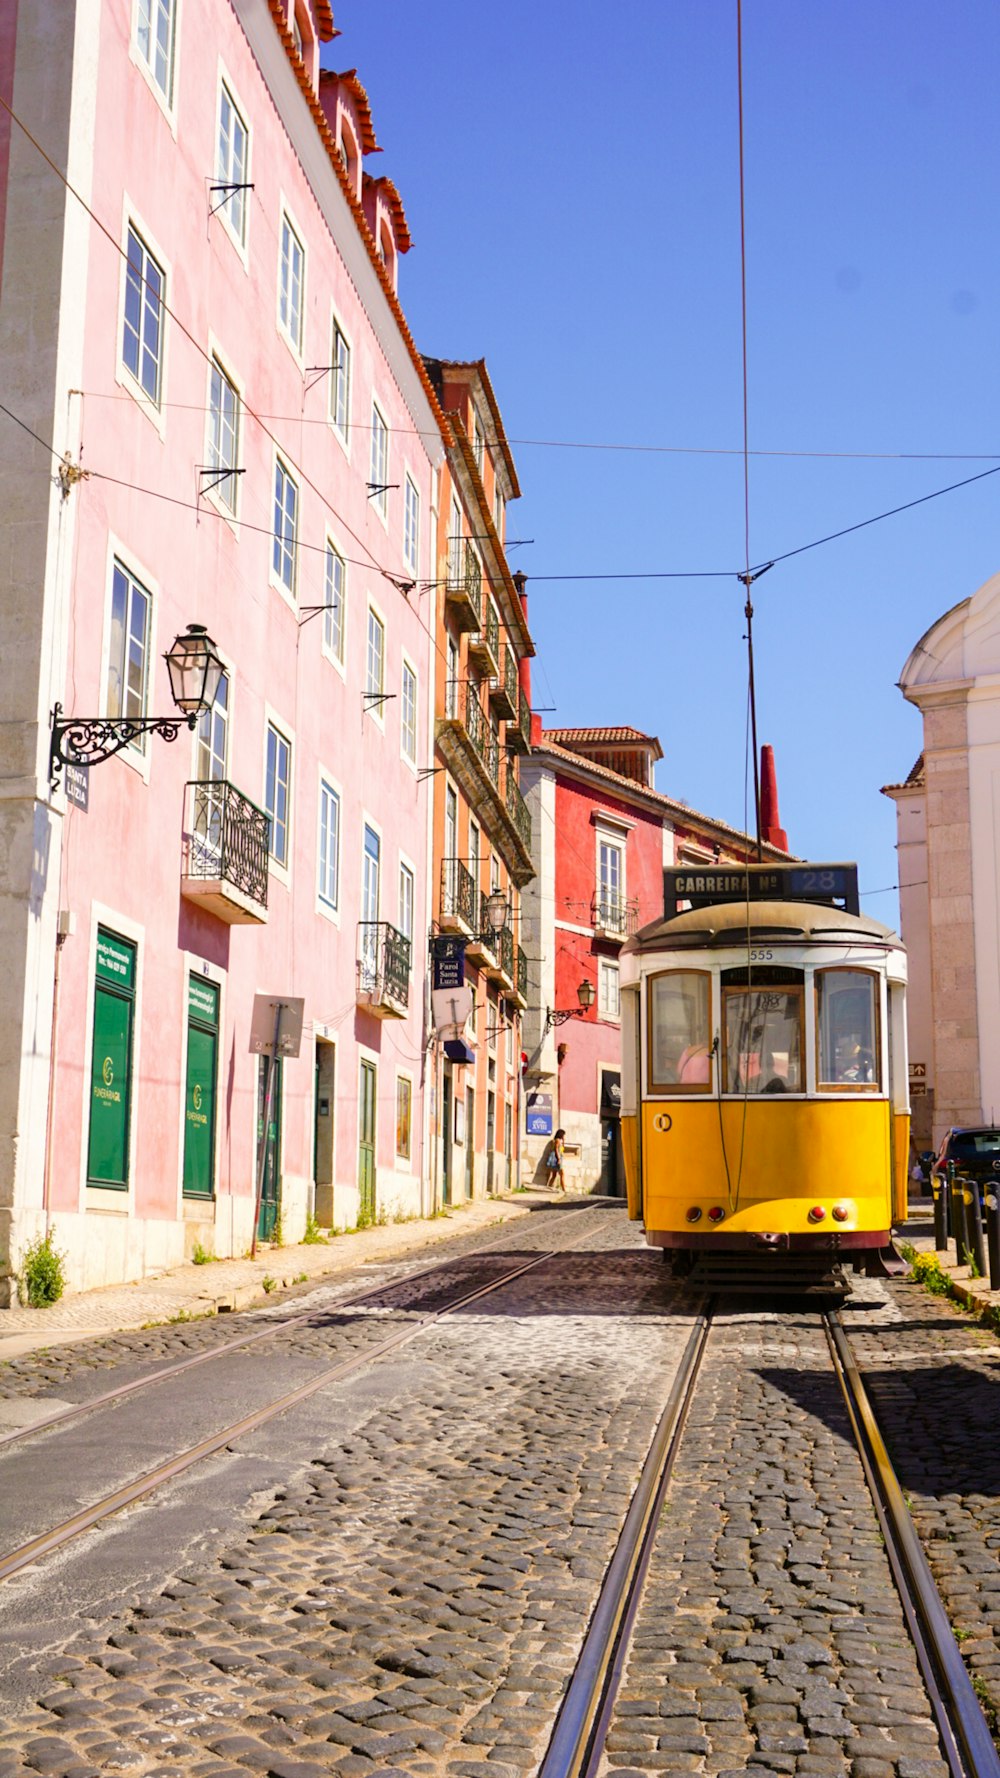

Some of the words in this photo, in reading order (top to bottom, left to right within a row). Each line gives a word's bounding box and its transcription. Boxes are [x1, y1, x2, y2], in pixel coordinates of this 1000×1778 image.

[66, 765, 88, 789] SANTA
[66, 781, 87, 804] LUZIA
[675, 876, 749, 893] CARREIRA
[802, 870, 836, 891] 28
[750, 950, 774, 961] 555
[439, 962, 459, 971] Farol
[439, 971, 458, 979] Santa
[439, 977, 459, 985] Luzia
